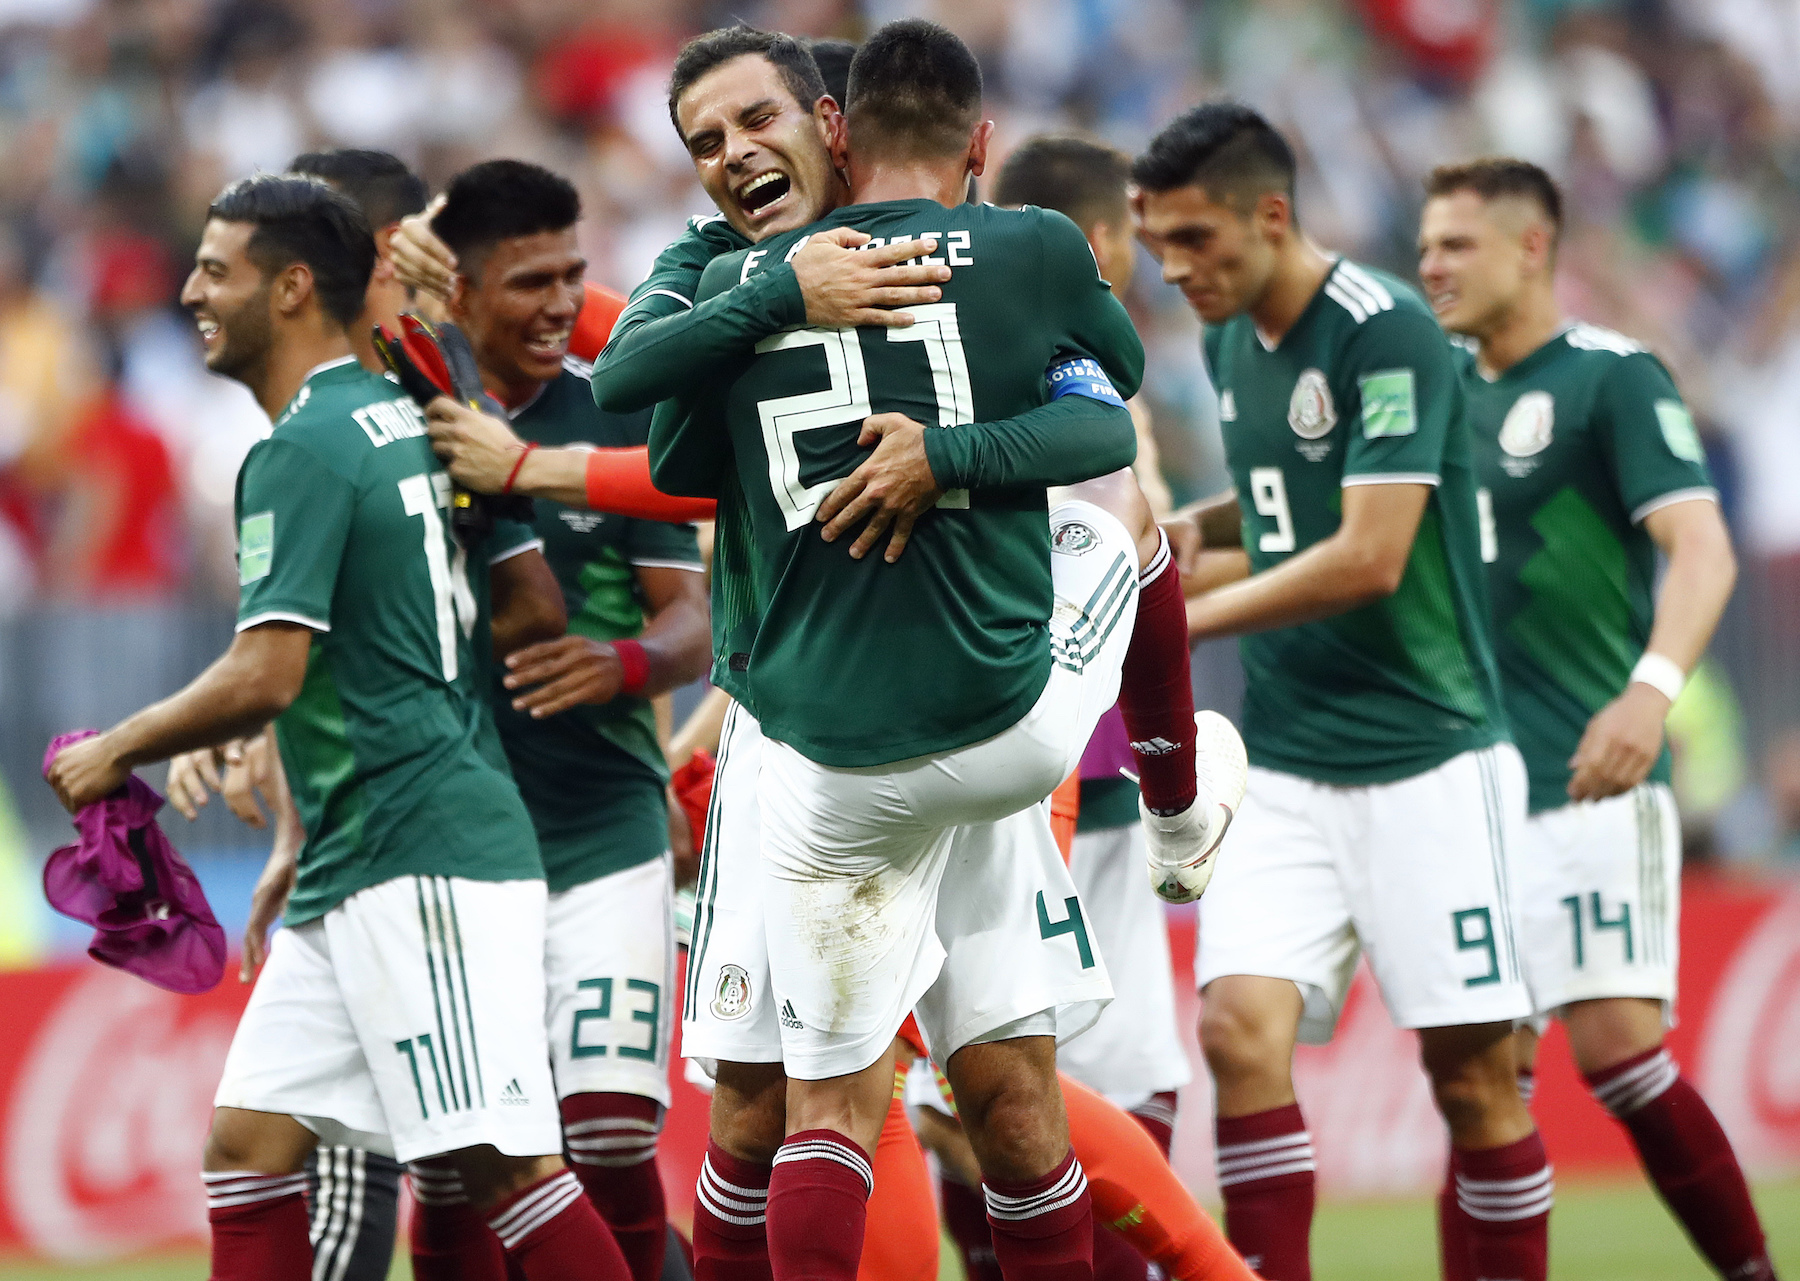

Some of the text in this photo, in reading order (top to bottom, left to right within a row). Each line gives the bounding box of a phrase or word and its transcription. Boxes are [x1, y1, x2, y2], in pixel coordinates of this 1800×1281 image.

[1250, 467, 1296, 553] 9
[1036, 889, 1096, 970] 4
[1451, 906, 1501, 987] 9
[1559, 891, 1635, 969] 14
[570, 977, 660, 1062] 23
[394, 1033, 448, 1120] 11
